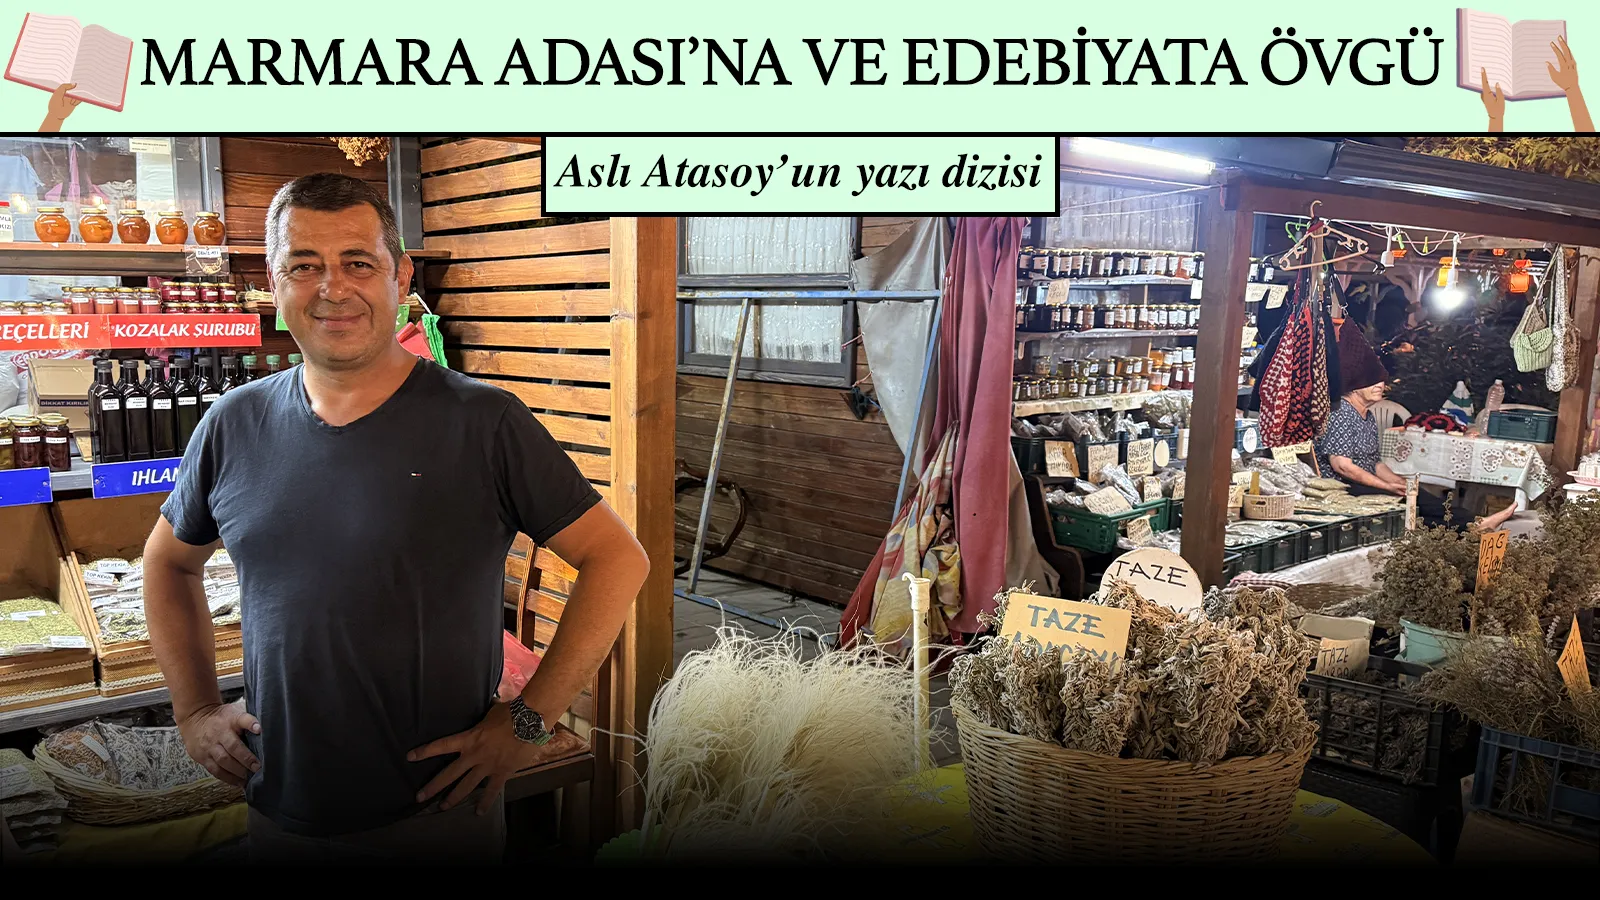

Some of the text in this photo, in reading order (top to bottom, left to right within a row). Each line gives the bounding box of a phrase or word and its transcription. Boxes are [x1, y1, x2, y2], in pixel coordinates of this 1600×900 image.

[0, 322, 89, 343] EÇELLERİ
[114, 323, 256, 338] KOZALAK ŞURUBU
[1115, 559, 1188, 588] TAZE
[1027, 603, 1106, 639] TAZE
[1321, 646, 1349, 667] TAZE
